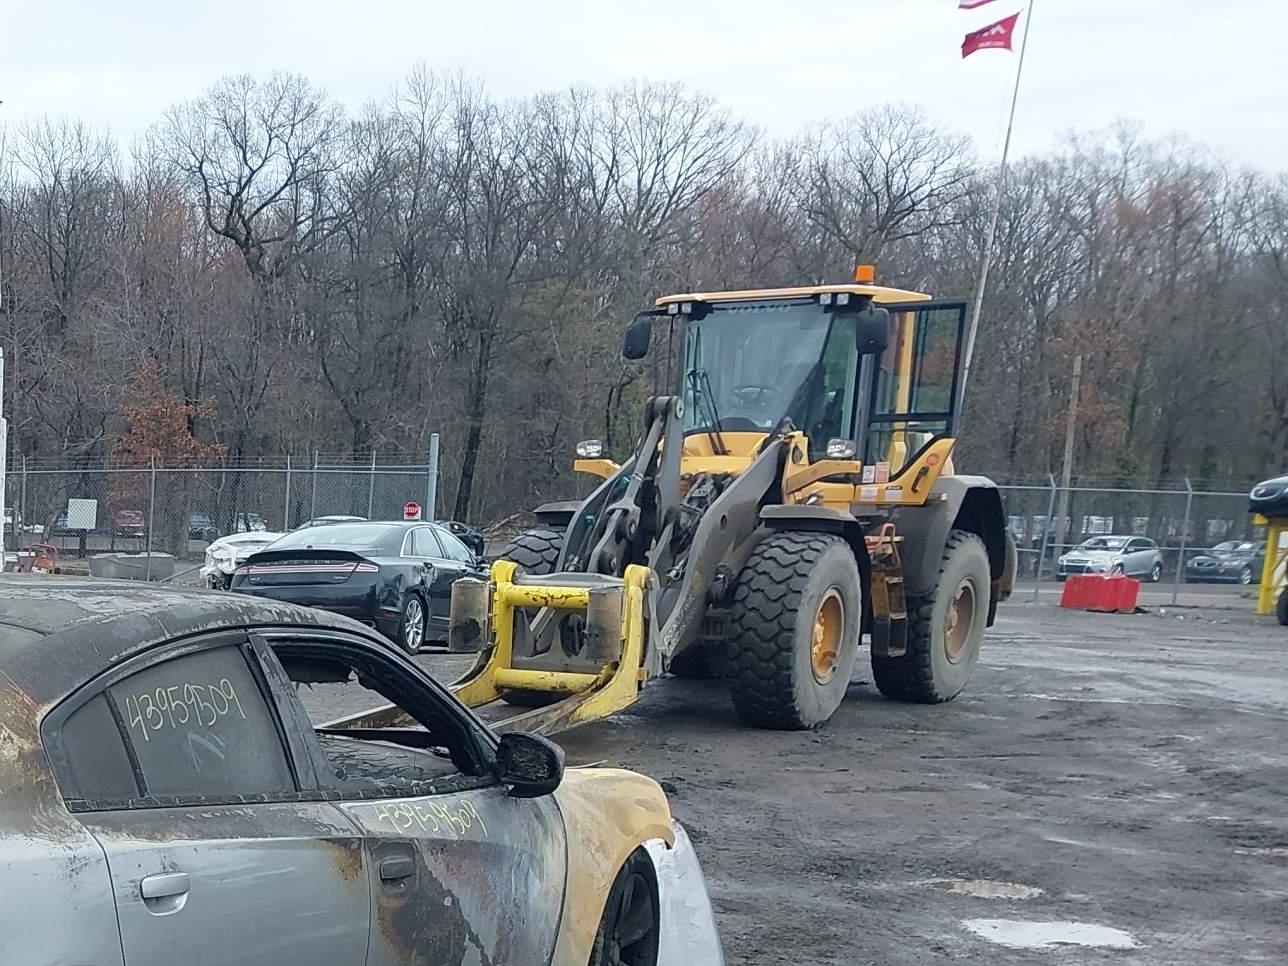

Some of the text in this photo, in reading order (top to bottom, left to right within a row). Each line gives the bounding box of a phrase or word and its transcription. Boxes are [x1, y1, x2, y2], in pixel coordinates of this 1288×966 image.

[404, 506, 419, 514] STOP
[126, 678, 246, 741] 43959509
[374, 799, 488, 838] 43959509
